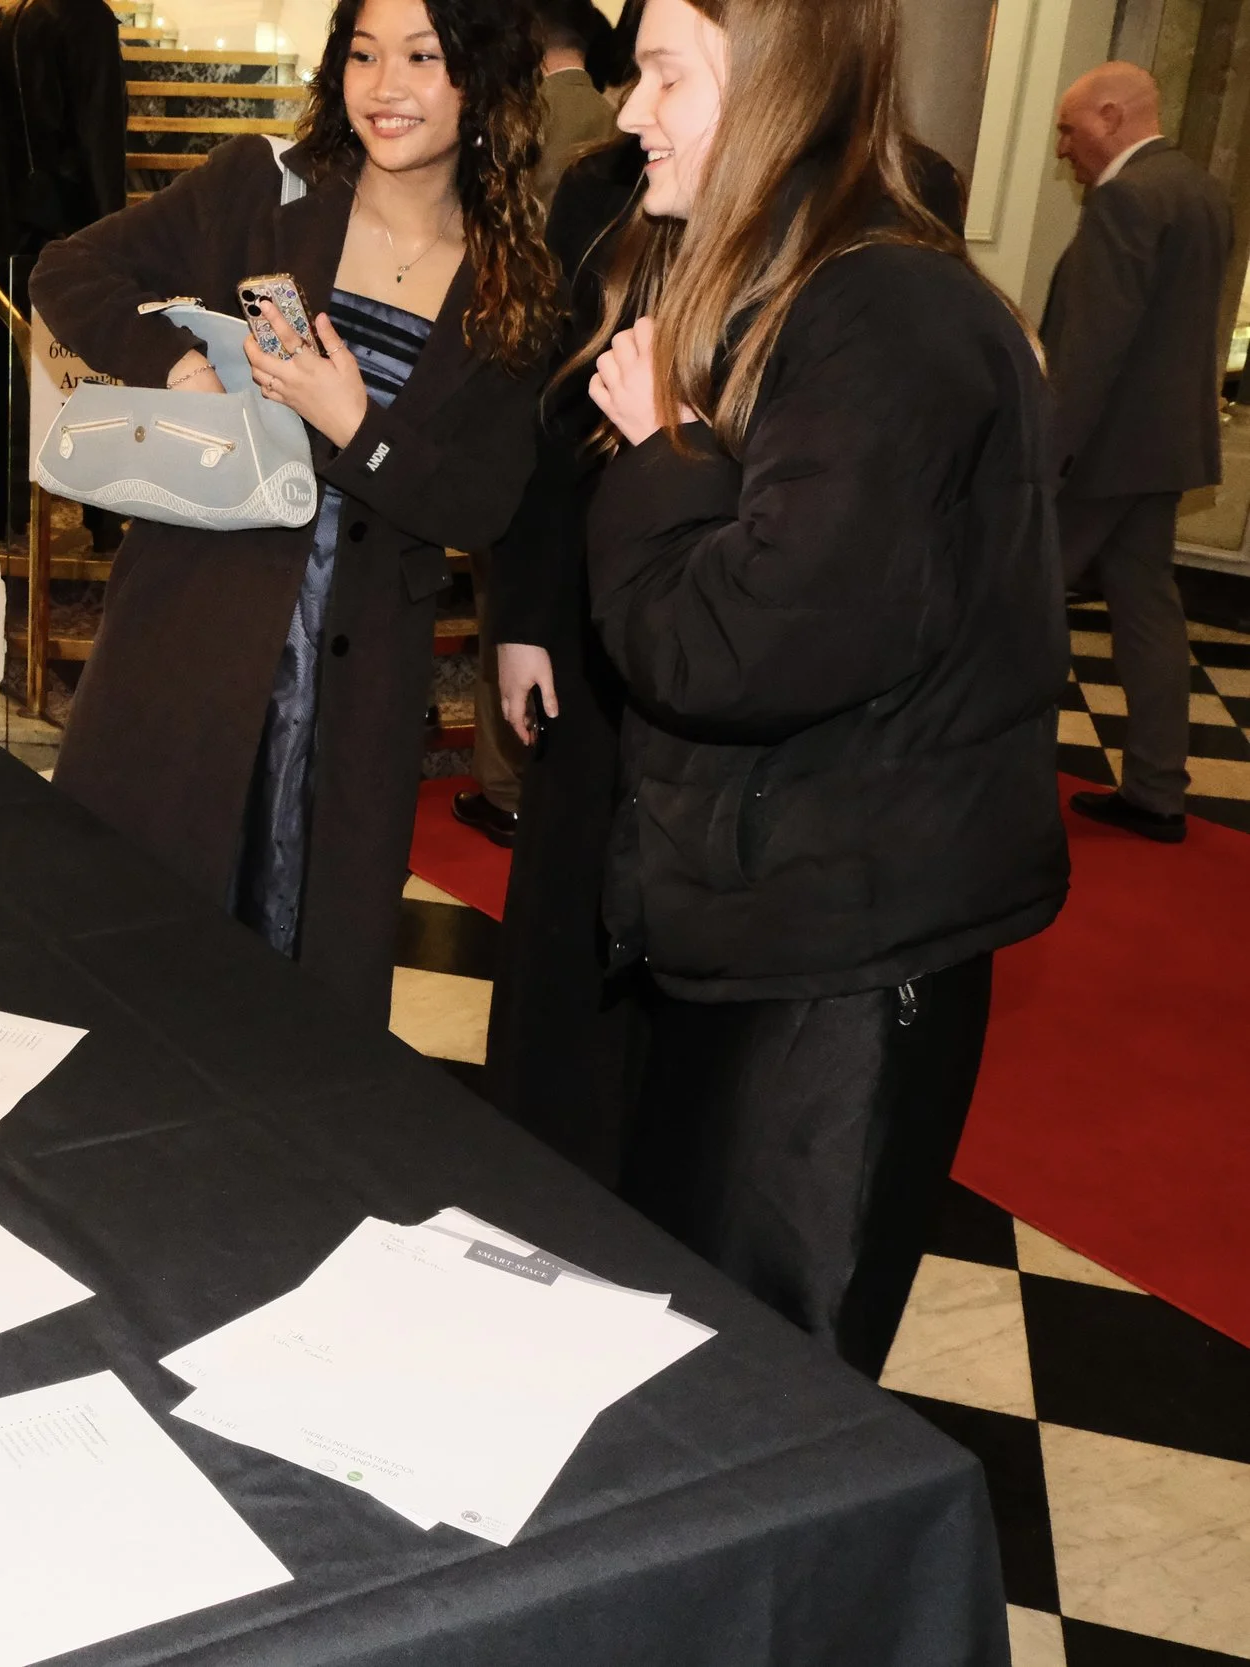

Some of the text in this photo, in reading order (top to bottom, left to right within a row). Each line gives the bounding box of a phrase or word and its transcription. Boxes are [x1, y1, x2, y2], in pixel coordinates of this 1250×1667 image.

[49, 340, 79, 359] 60
[366, 442, 390, 472] DKNY
[285, 482, 311, 502] Dior
[476, 1249, 514, 1267] SMART
[514, 1262, 550, 1279] SPACE
[304, 1436, 330, 1452] THAN
[331, 1446, 349, 1459] PEN
[350, 1455, 371, 1468] AND
[371, 1463, 400, 1479] PAPER
[332, 1439, 349, 1451] NO
[349, 1445, 389, 1466] GREATER
[390, 1461, 416, 1477] TOOL
